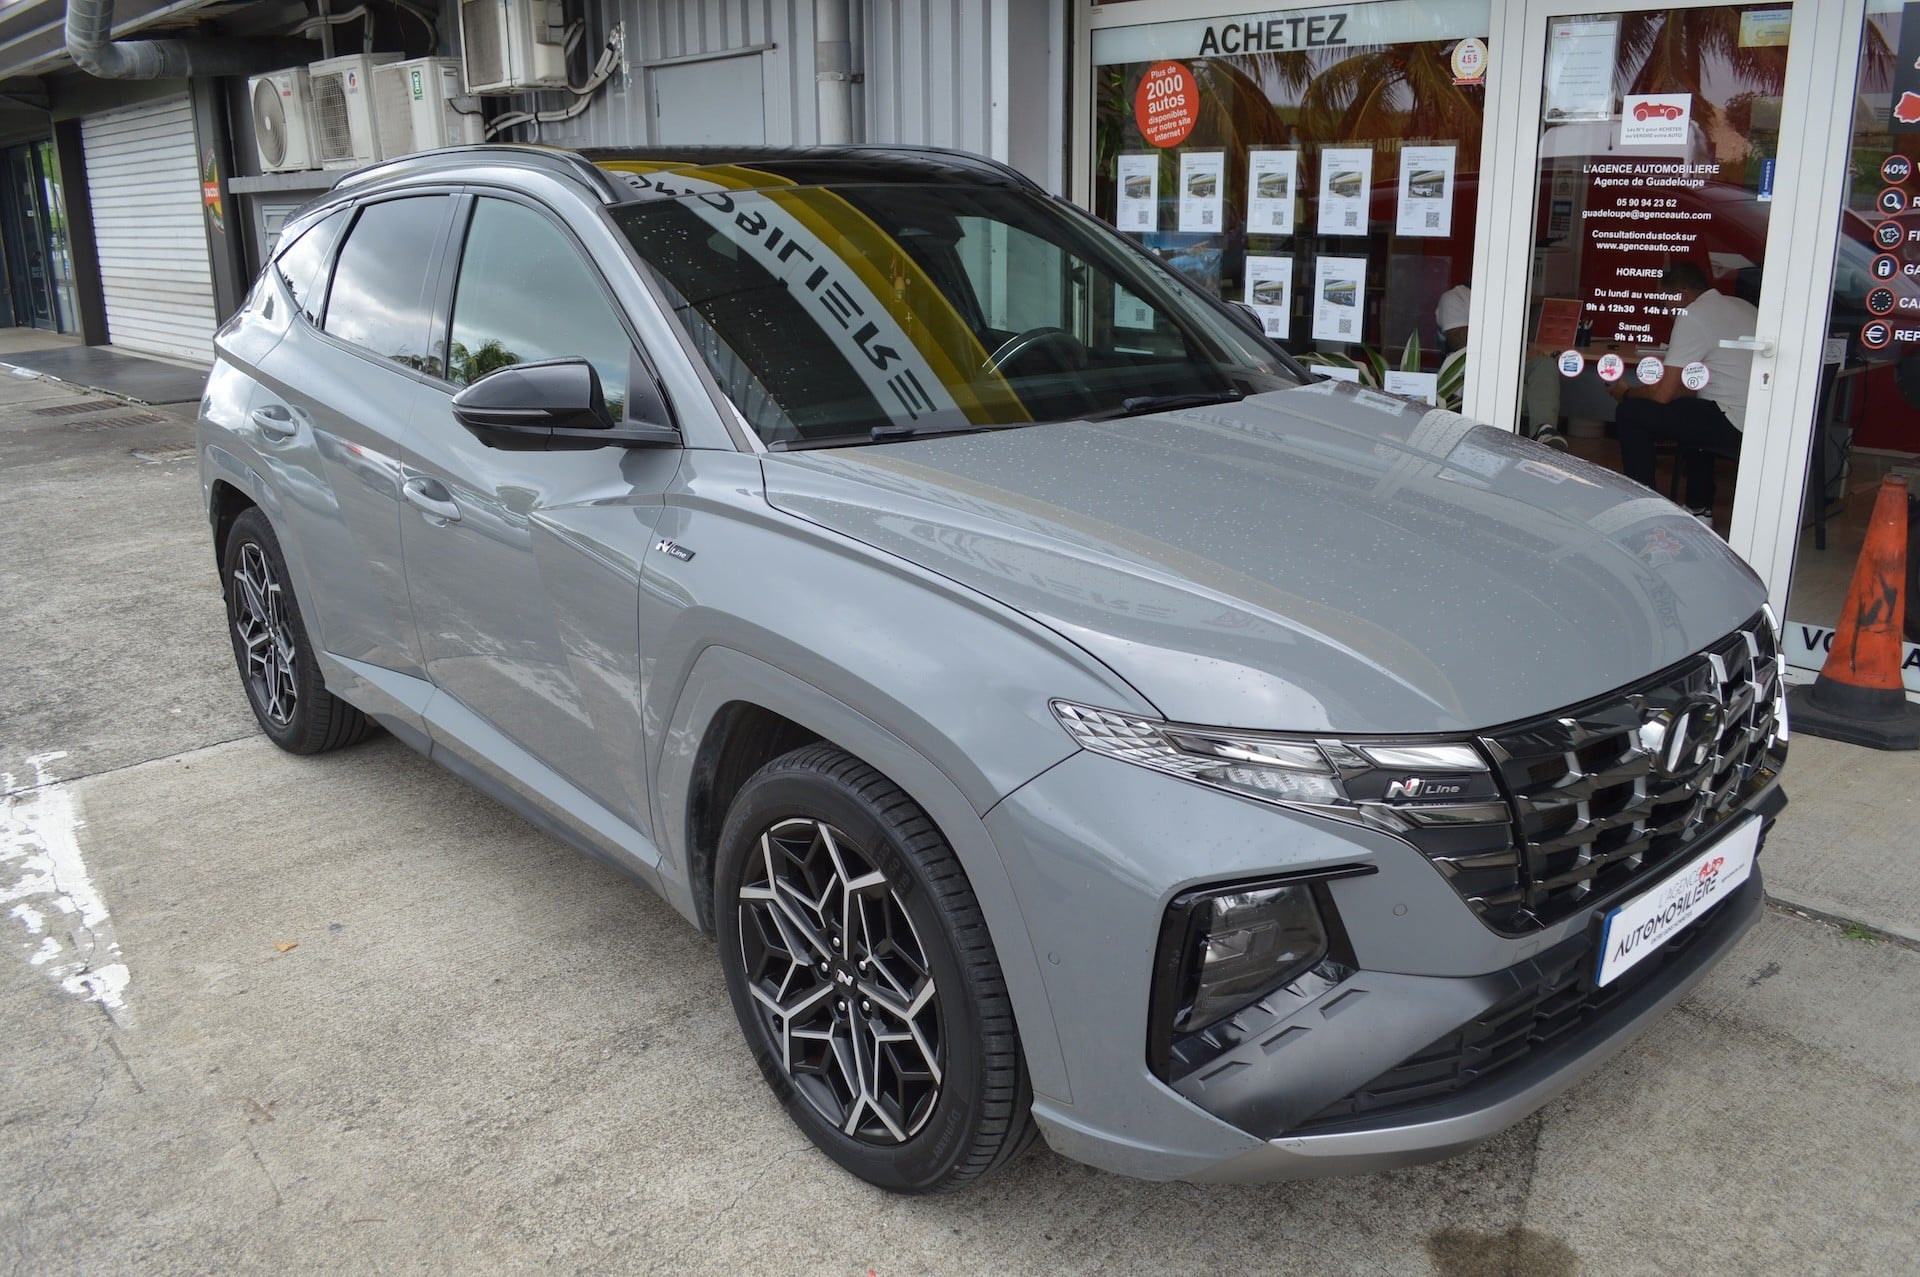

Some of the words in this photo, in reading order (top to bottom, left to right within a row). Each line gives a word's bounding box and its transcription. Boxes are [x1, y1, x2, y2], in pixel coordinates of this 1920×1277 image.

[1199, 13, 1347, 56] ACHETEZ
[1151, 69, 1166, 79] Plus
[1167, 65, 1177, 74] de
[1146, 74, 1183, 100] 2000
[1148, 94, 1185, 114] autos
[1148, 108, 1188, 125] disponibles
[1146, 126, 1158, 135] sur
[1159, 120, 1177, 131] notre
[1178, 117, 1191, 126] site
[1154, 129, 1181, 142] internet
[1583, 164, 1632, 174] L'AGENCE
[1634, 164, 1720, 174] AUTOMOBILIERE
[1884, 164, 1908, 175] 40%
[1594, 177, 1630, 188] Agence
[1631, 177, 1643, 186] de
[1646, 177, 1705, 189] Guadeloupe
[1616, 198, 1627, 207] 05
[1628, 198, 1640, 207] 90
[1641, 199, 1652, 207] 94
[1653, 199, 1664, 207] 23
[1666, 199, 1677, 208] 62
[1582, 209, 1712, 220] guadeloupe@agenceauto.com
[1596, 242, 1689, 252] www.agenceauto.com
[1616, 268, 1663, 278] HORAIRES
[1594, 288, 1606, 297] Du
[1608, 288, 1629, 298] lundi
[1644, 292, 1682, 301] vendredi
[1586, 303, 1597, 311] 9h
[1599, 303, 1605, 311] à
[1607, 304, 1635, 313] 12h30
[1642, 306, 1660, 315] 14h
[1662, 306, 1668, 315] à
[1670, 307, 1688, 316] 17h
[1618, 322, 1650, 332] Samedi
[1614, 333, 1625, 341] 9h
[1628, 333, 1634, 342] à
[1636, 334, 1653, 342] 12h
[670, 547, 687, 559] Line
[1425, 784, 1460, 795] Line
